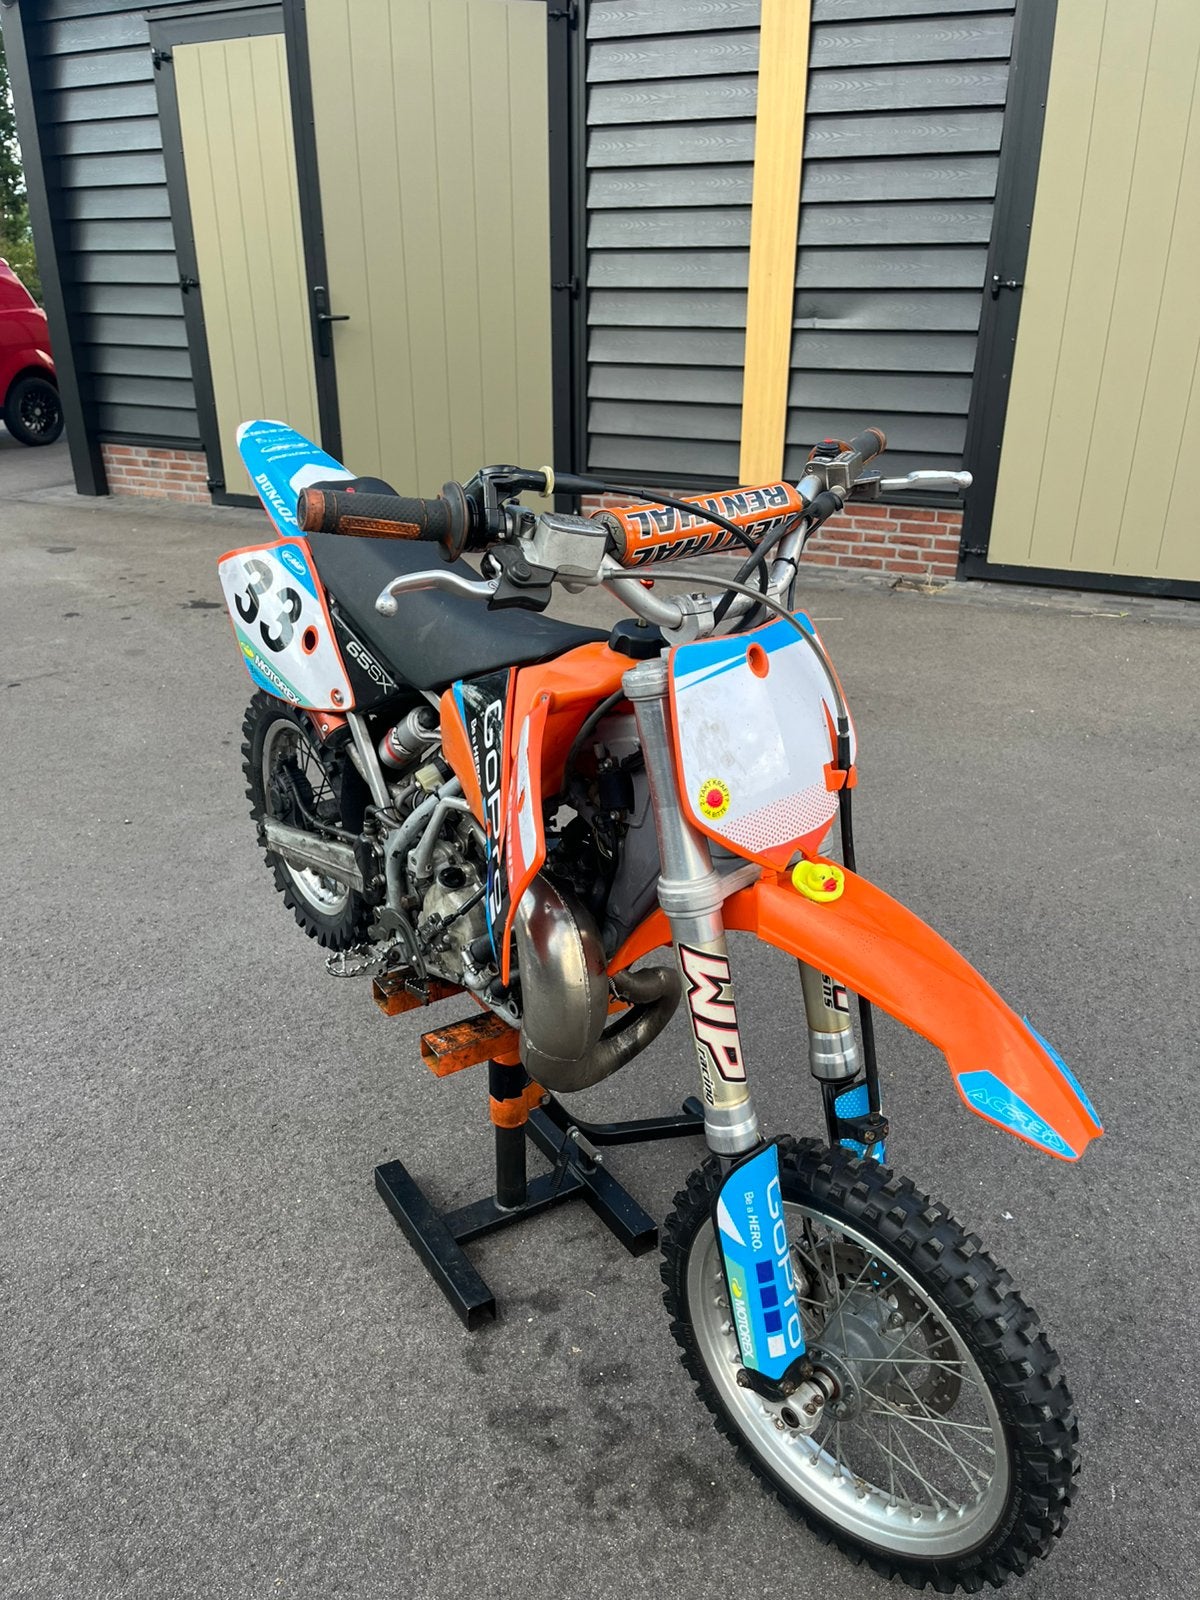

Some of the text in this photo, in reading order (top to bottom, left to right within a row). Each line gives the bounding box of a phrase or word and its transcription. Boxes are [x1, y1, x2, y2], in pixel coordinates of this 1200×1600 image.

[255, 472, 299, 526] DUNLOP
[235, 559, 302, 652] 33
[255, 654, 301, 704] MOTOREX
[346, 641, 392, 694] 65SX
[678, 943, 747, 1083] WP
[744, 1191, 755, 1205] Be
[735, 1299, 754, 1358] MOTOREX
